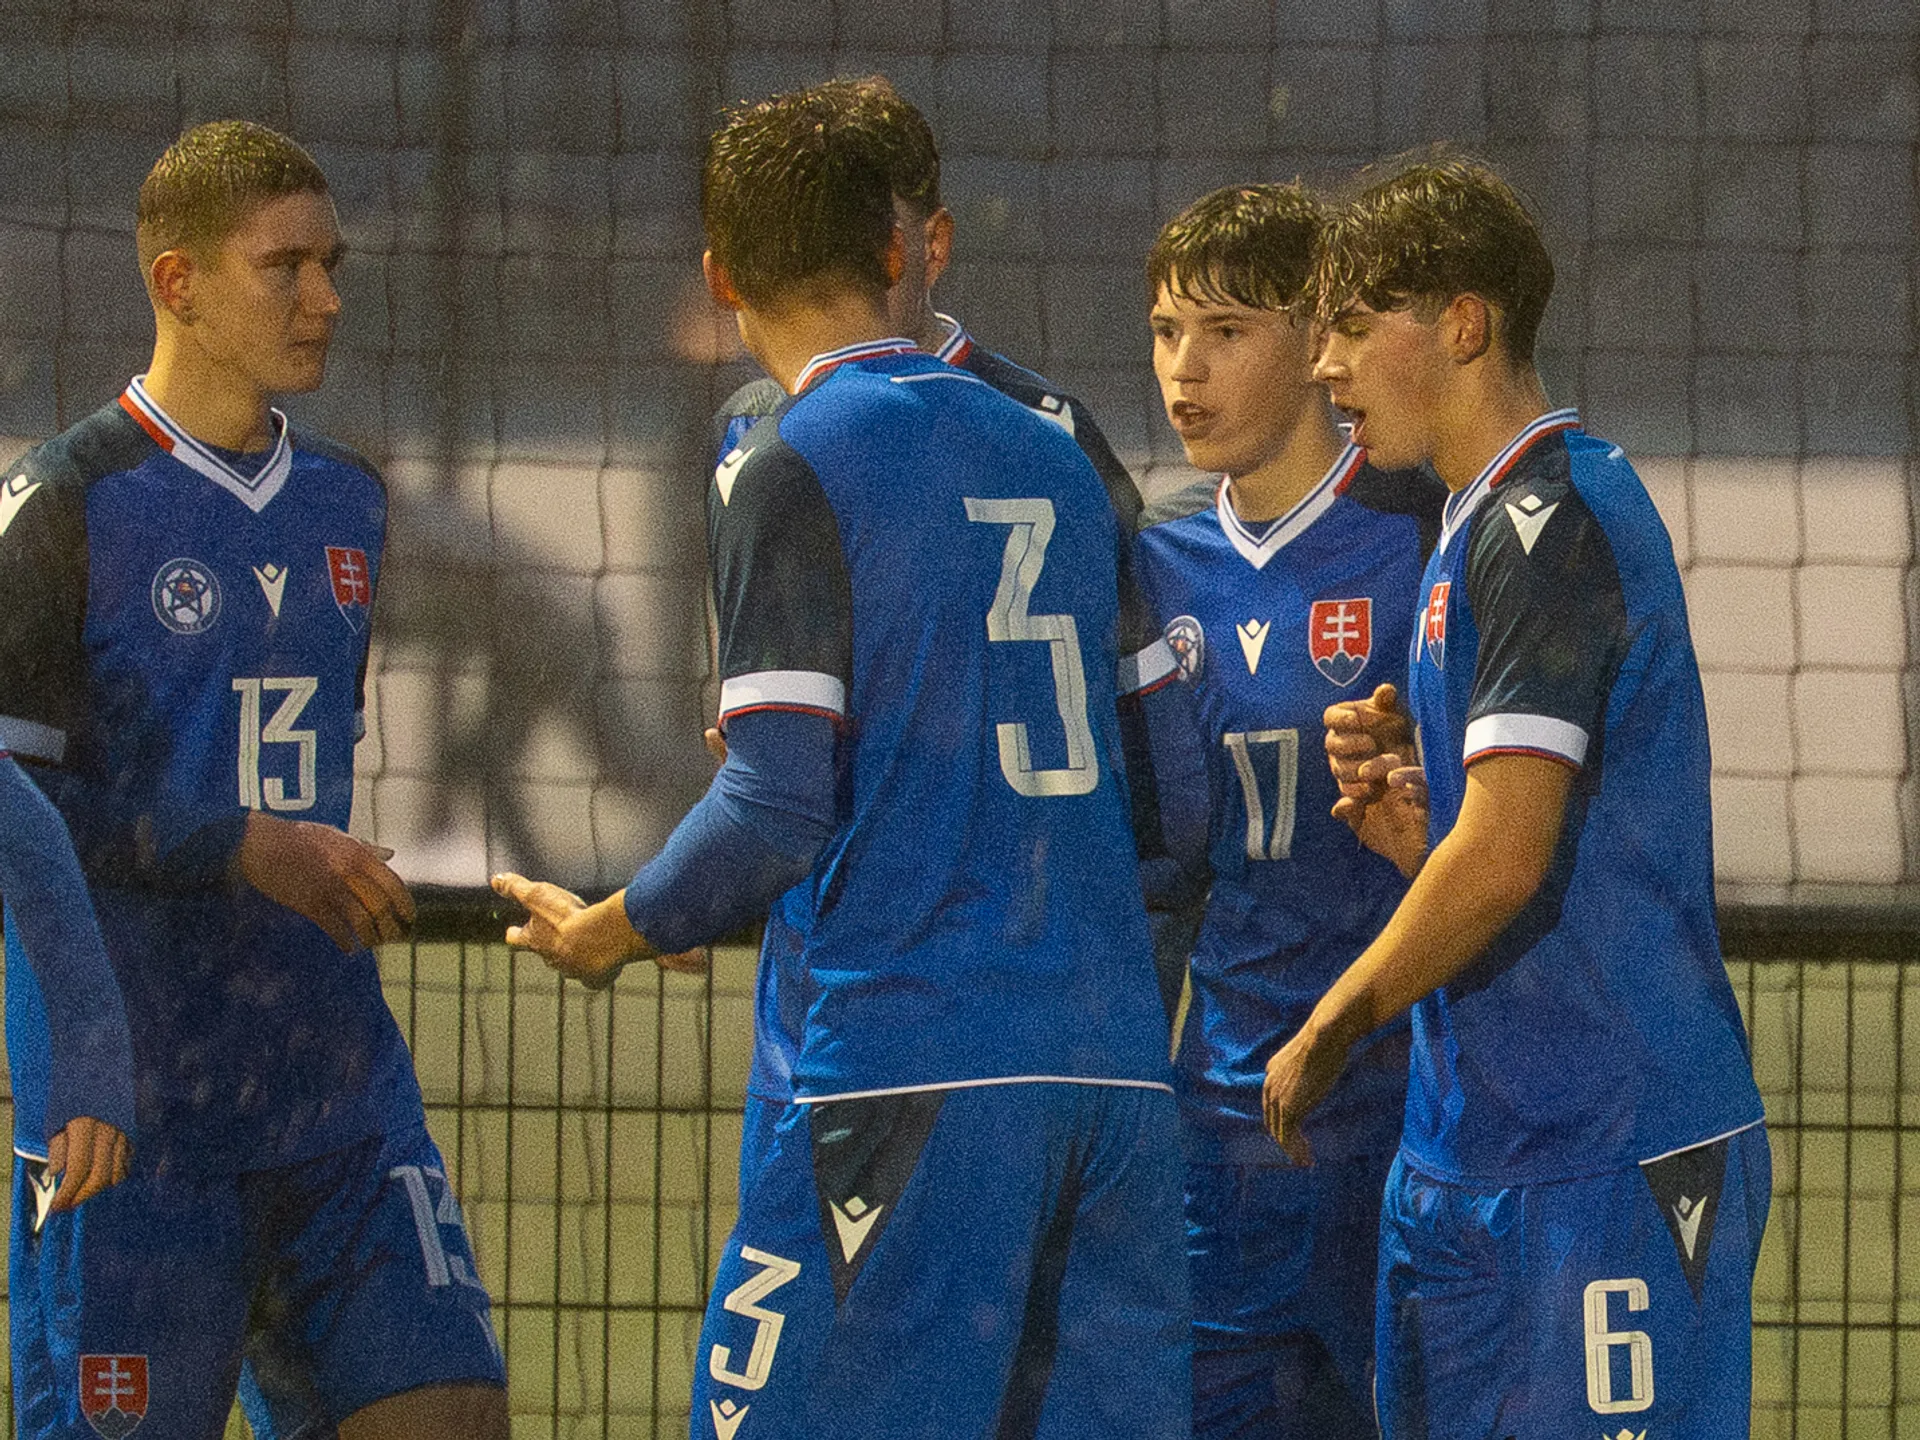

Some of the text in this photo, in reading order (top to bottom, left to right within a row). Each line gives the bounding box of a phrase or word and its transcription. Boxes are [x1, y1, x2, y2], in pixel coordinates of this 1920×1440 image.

[963, 497, 1099, 796] 3
[232, 676, 318, 811] 13
[1223, 728, 1299, 861] 17
[710, 1245, 801, 1390] 3
[1583, 1278, 1654, 1414] 6
